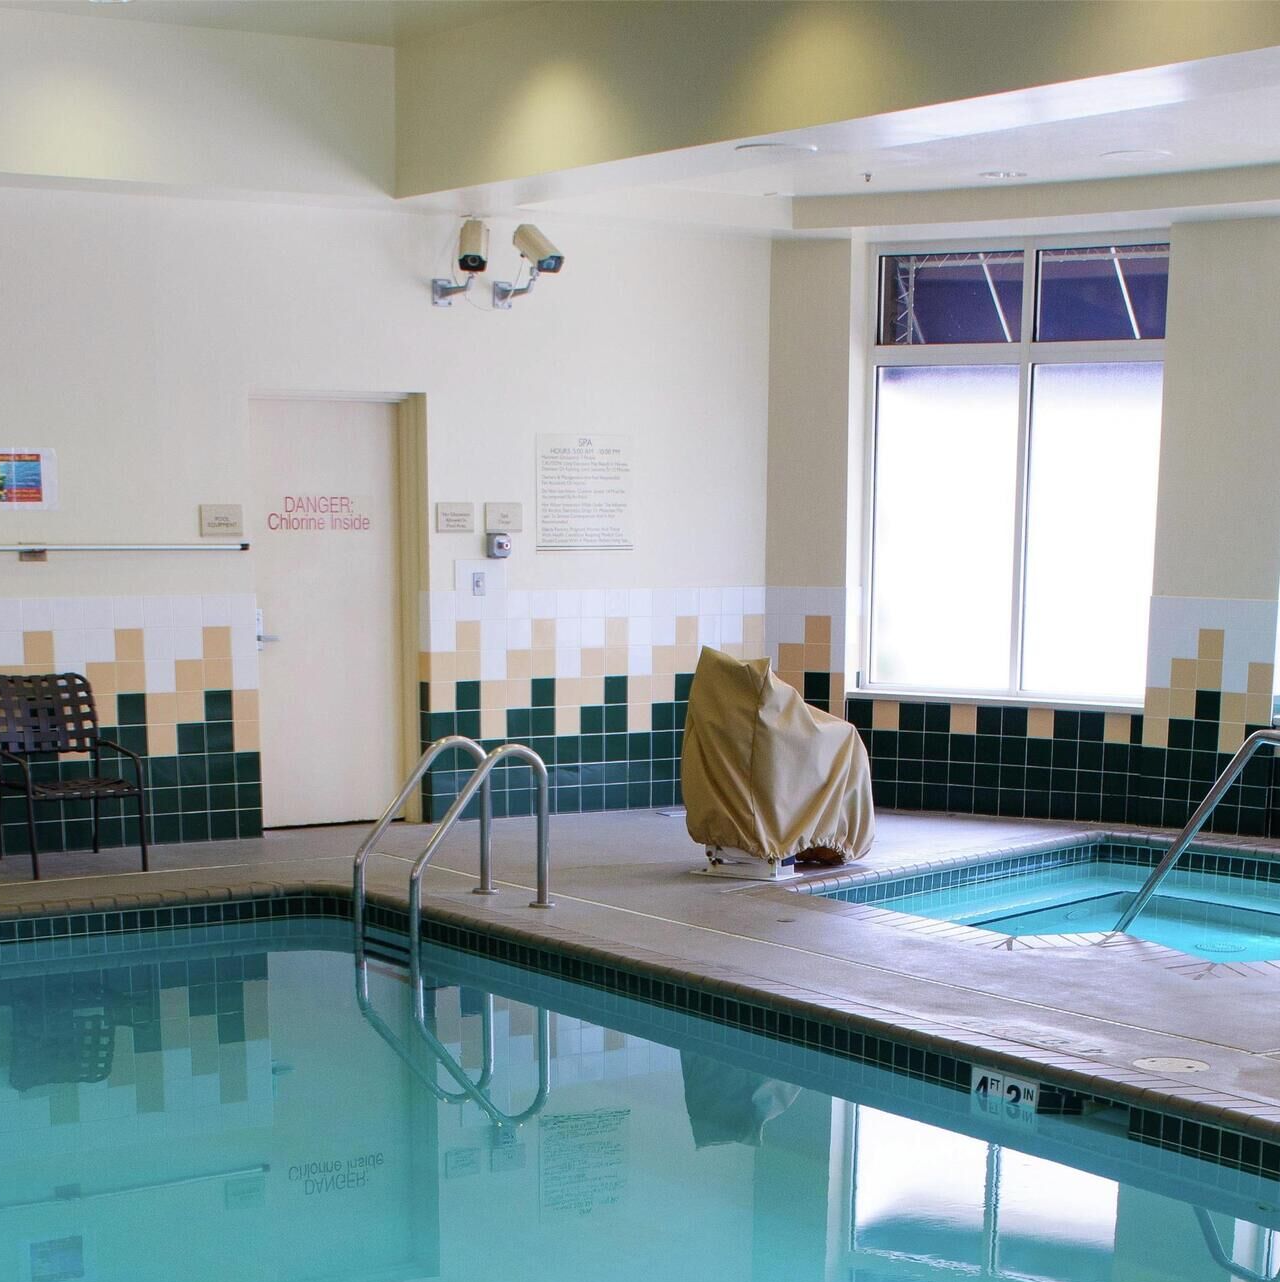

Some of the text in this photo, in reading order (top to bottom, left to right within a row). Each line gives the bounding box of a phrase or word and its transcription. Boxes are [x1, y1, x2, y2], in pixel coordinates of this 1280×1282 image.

[284, 496, 354, 514] DANGER:
[267, 512, 371, 531] Chlorine Inside
[990, 1078, 1000, 1091] FT
[1007, 1085, 1021, 1103] 2
[1023, 1088, 1034, 1102] IN
